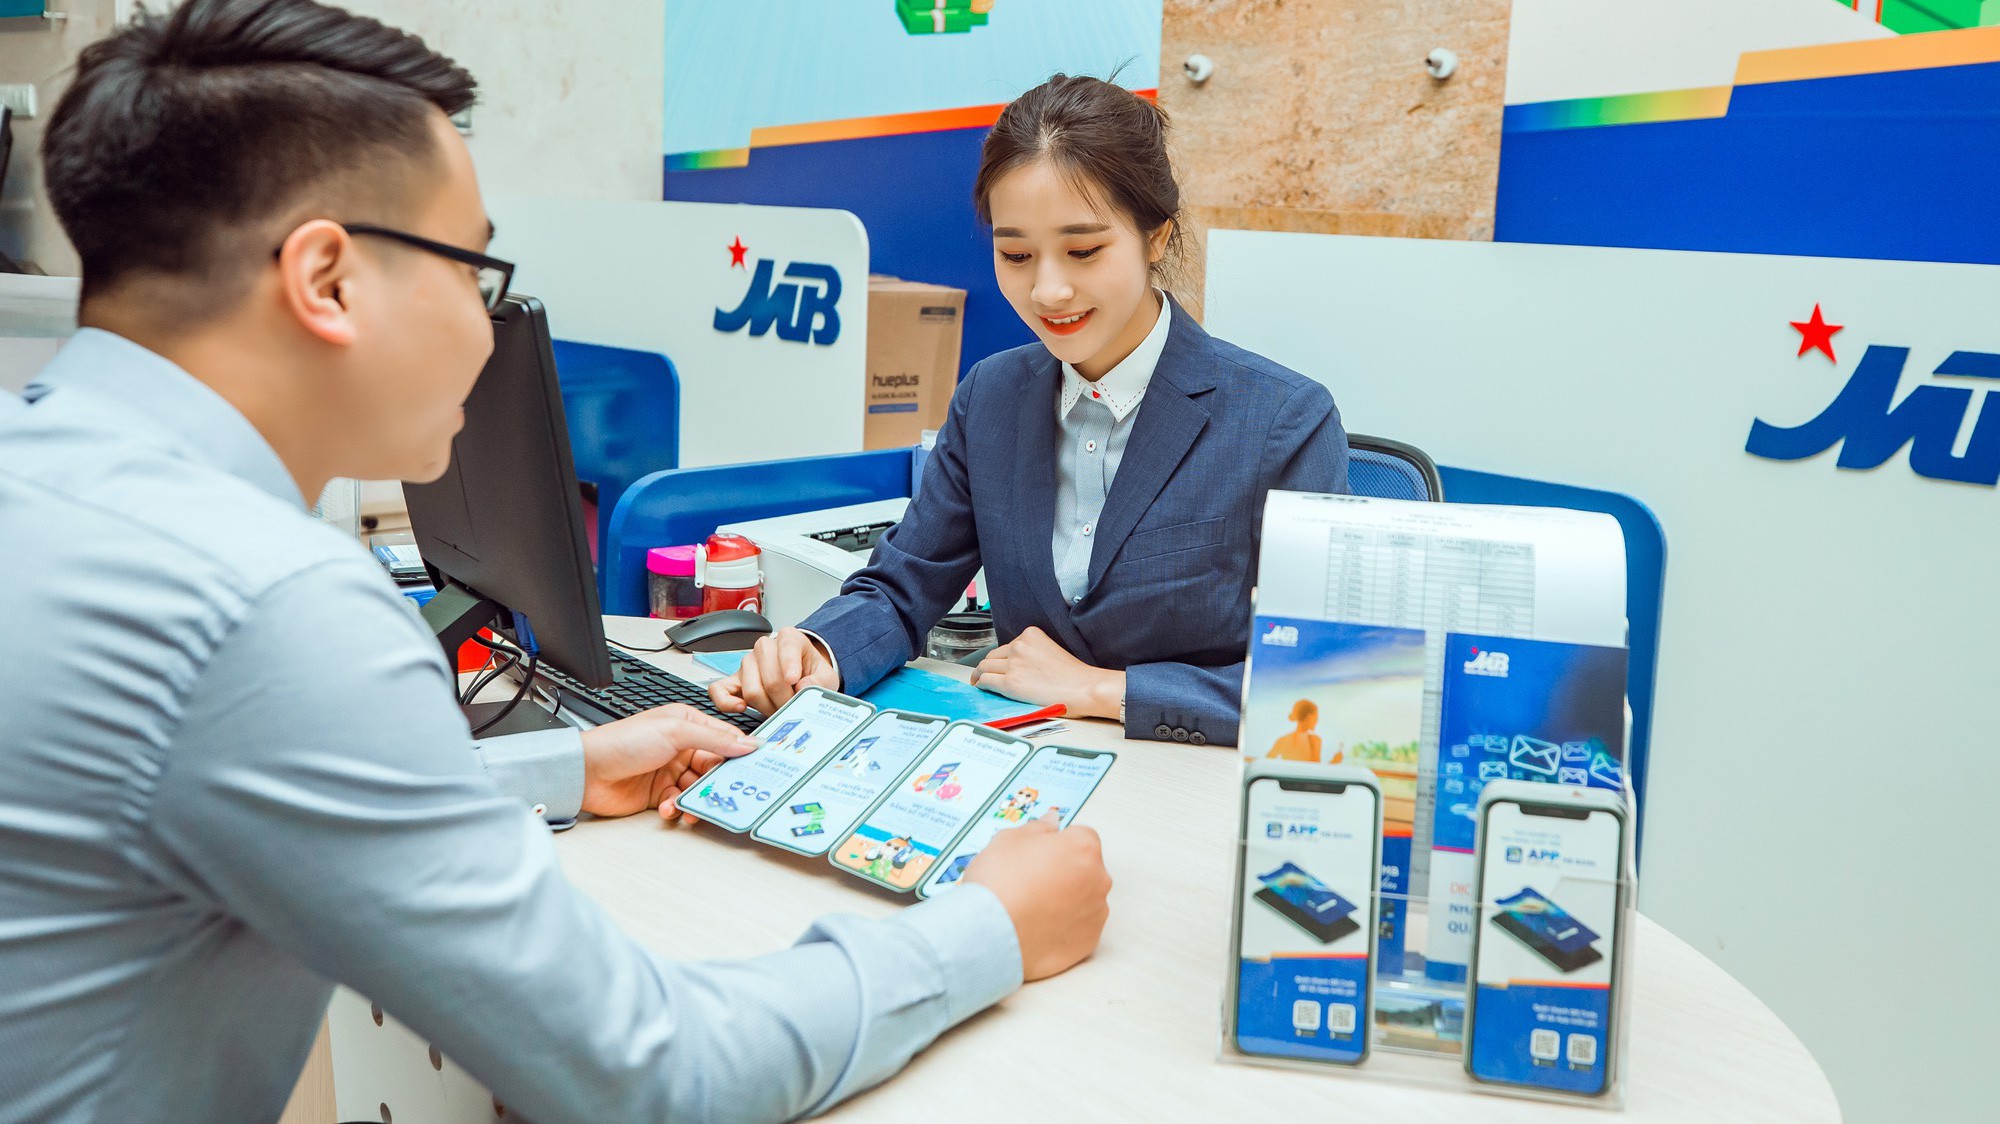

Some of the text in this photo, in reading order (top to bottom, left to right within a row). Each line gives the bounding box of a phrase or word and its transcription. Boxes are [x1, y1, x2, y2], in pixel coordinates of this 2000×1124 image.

[713, 258, 842, 346] MB
[872, 373, 920, 388] hueplus
[1288, 825, 1318, 834] APP
[1528, 849, 1560, 860] APP
